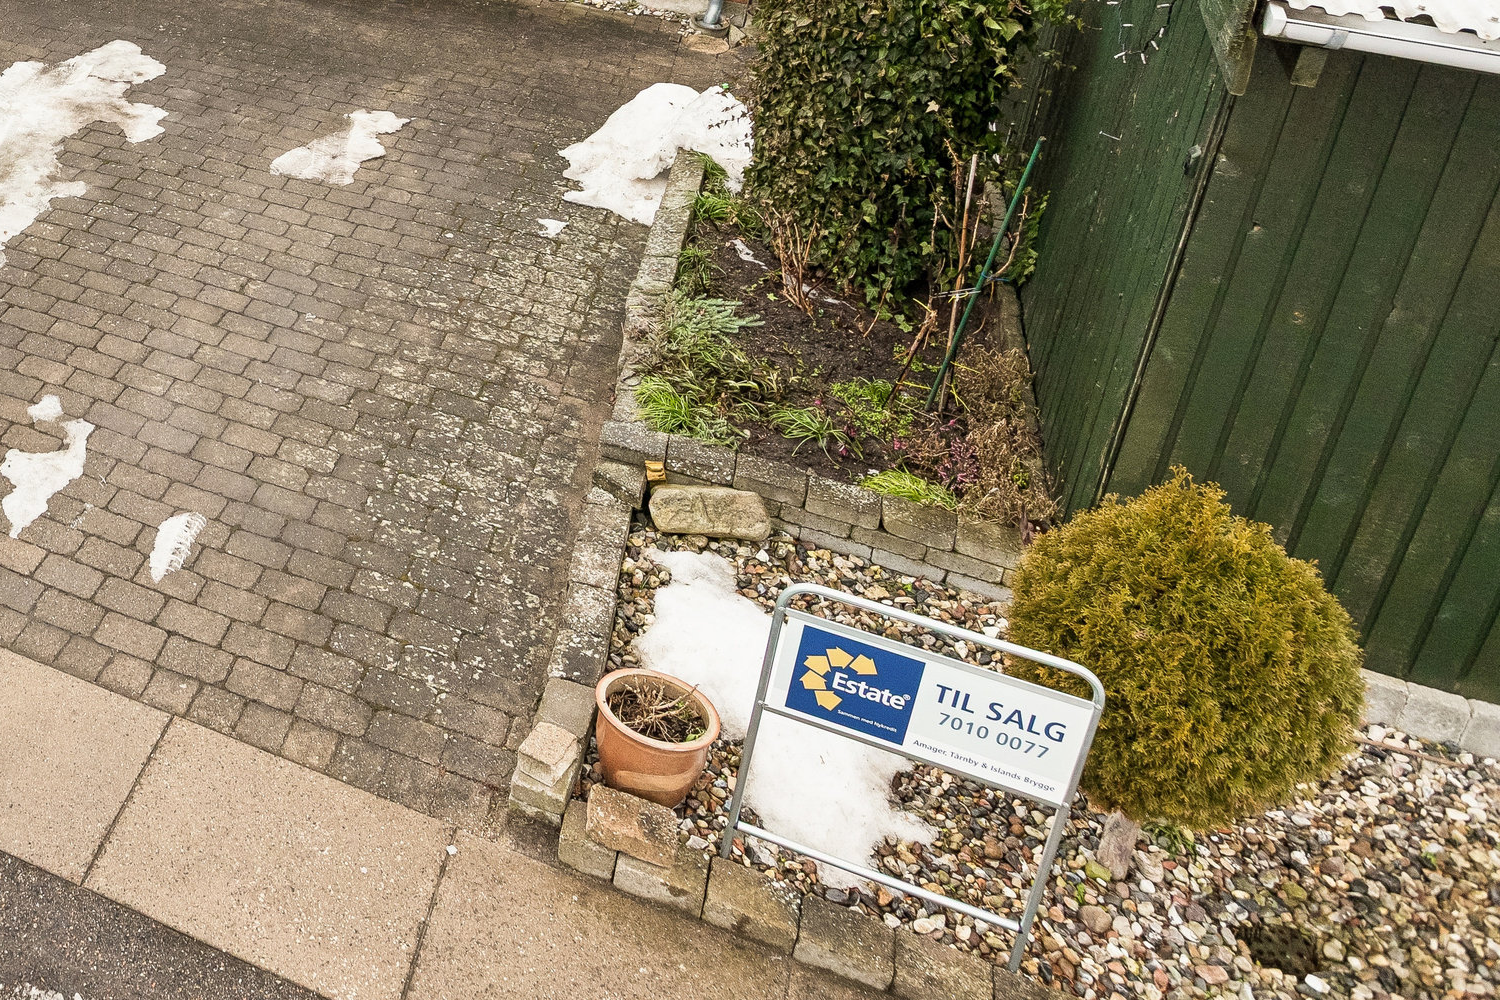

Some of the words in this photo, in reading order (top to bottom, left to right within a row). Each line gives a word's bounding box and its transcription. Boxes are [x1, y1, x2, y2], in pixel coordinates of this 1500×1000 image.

[831, 671, 905, 710] Estate
[936, 684, 975, 714] TIL
[985, 702, 1067, 743] SALG
[938, 712, 989, 739] 7010
[995, 732, 1050, 758] 0077
[912, 739, 947, 757] Amager,
[990, 765, 1021, 781] Islands
[1023, 776, 1056, 793] Brygge
